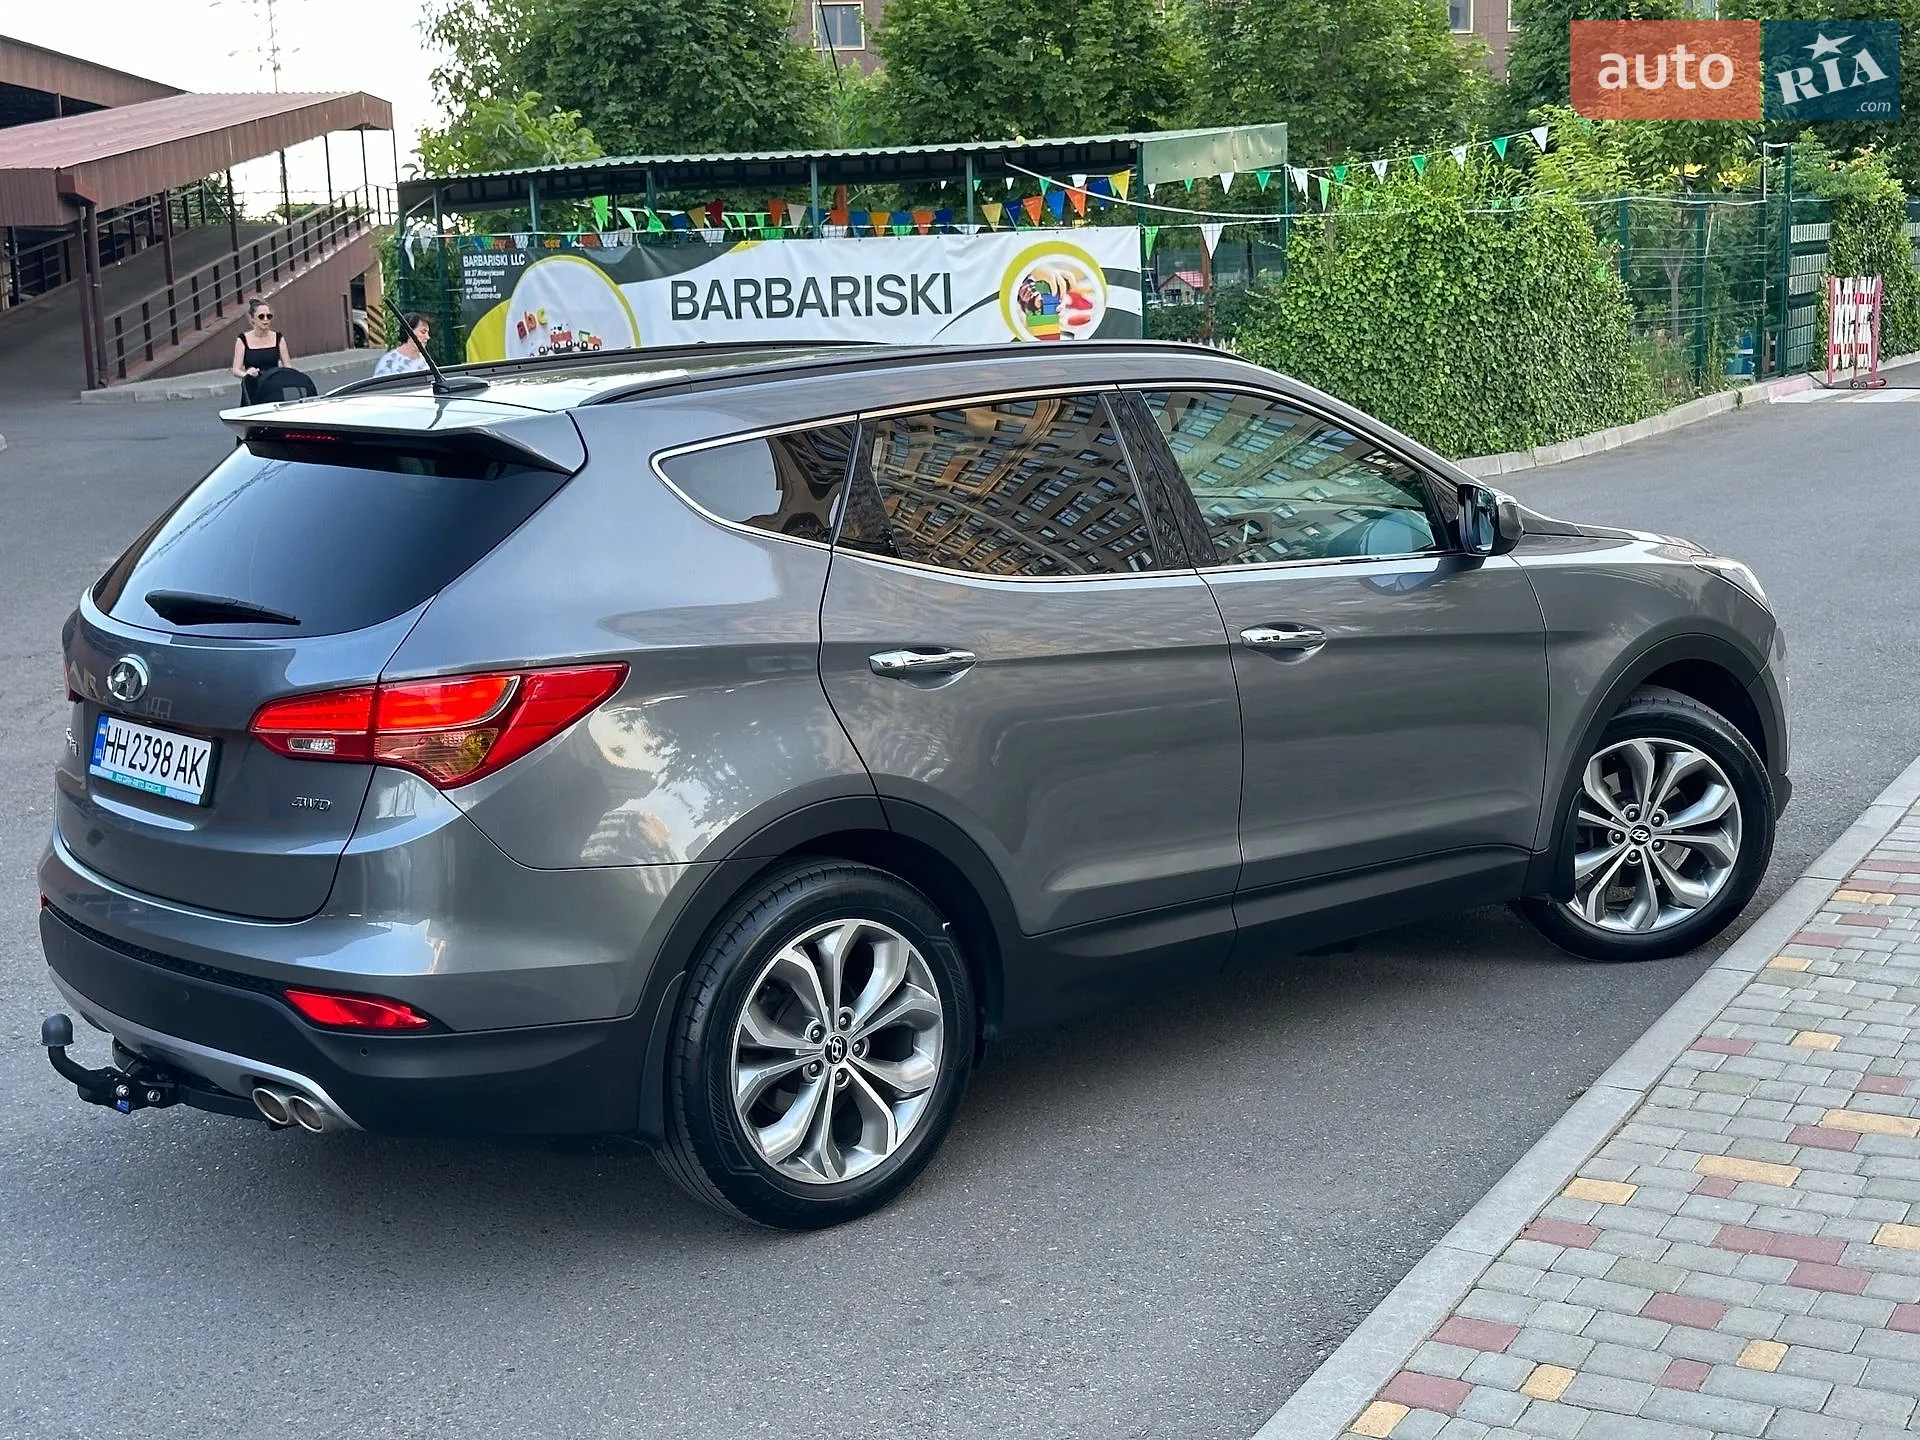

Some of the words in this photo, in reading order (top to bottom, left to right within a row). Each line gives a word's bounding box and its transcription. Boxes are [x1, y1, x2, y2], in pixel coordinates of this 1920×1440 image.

[462, 254, 509, 268] BARBARISKI
[510, 252, 526, 267] LLC
[670, 272, 953, 321] BARBARISKI
[103, 725, 131, 767] HH
[128, 732, 174, 778] 2398
[173, 744, 208, 788] AK
